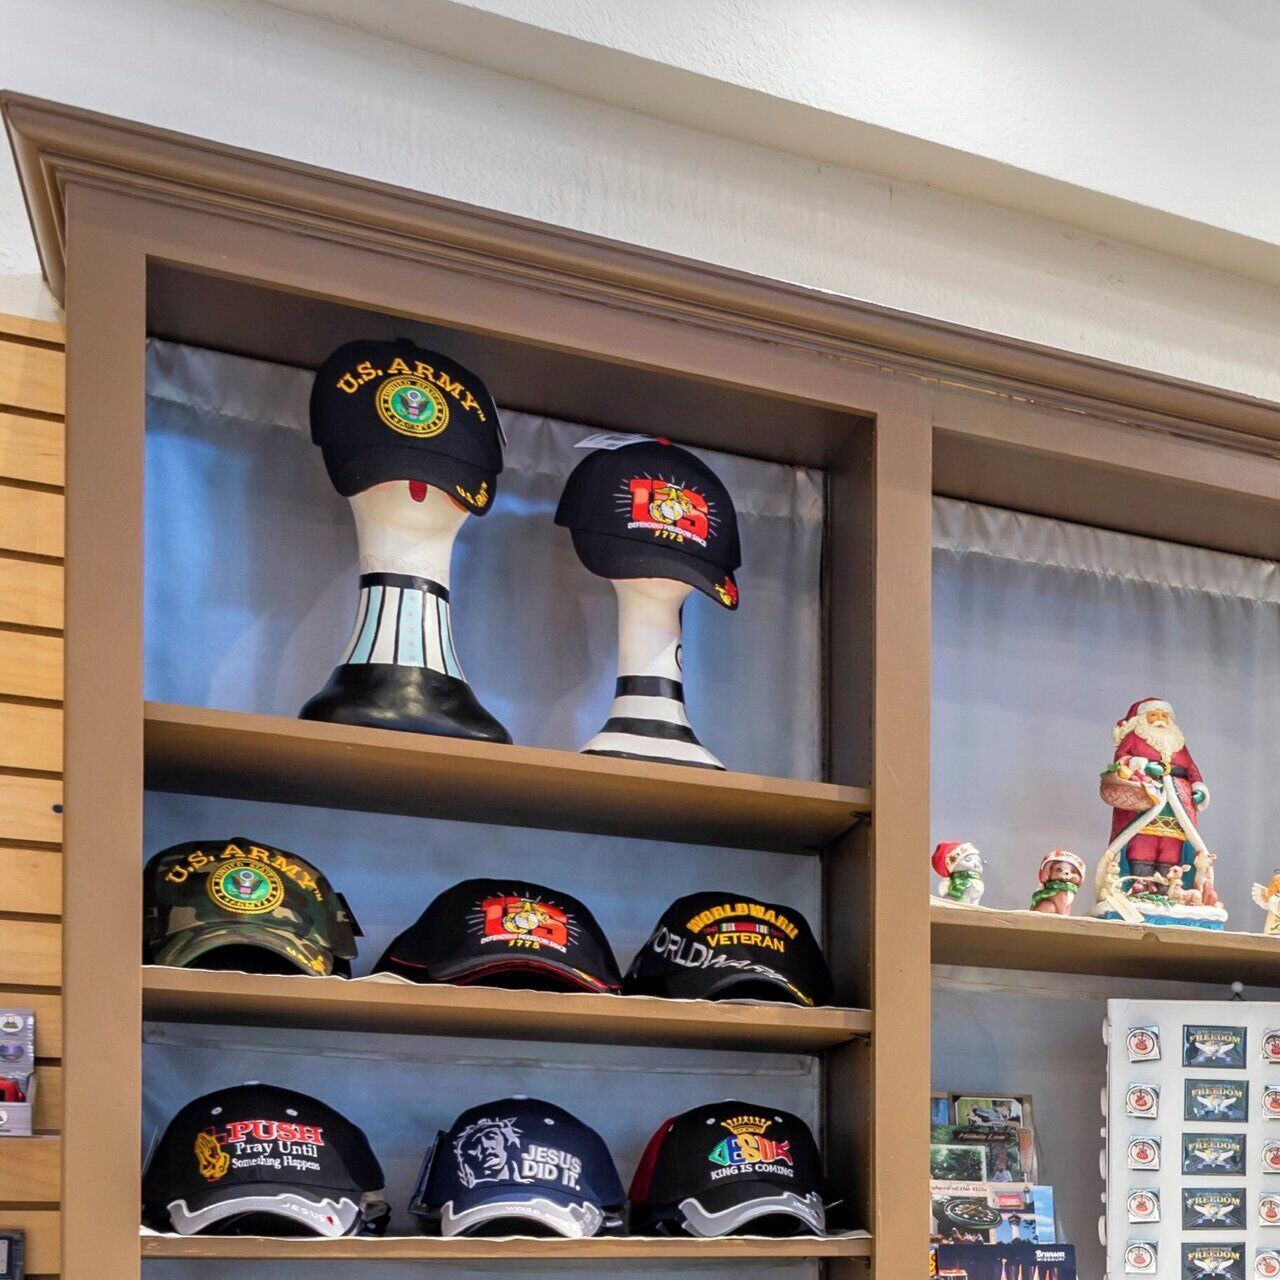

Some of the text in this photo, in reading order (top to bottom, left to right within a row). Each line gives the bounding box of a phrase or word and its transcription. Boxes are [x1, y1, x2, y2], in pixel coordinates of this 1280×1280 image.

[336, 361, 383, 396] U.S.
[165, 851, 214, 884] U.S.
[706, 932, 785, 953] VETERAN
[1189, 1034, 1241, 1044] FREEDOM
[1191, 1088, 1243, 1098] FREEDOM
[226, 1120, 324, 1146] PUSH
[235, 1141, 317, 1157] Pray Until
[1188, 1142, 1241, 1152] FREEDOM
[232, 1155, 320, 1171] Something Happens
[522, 1144, 582, 1174] JESUS
[522, 1161, 581, 1191] DID IT.
[711, 1163, 794, 1180] KING IS COMING
